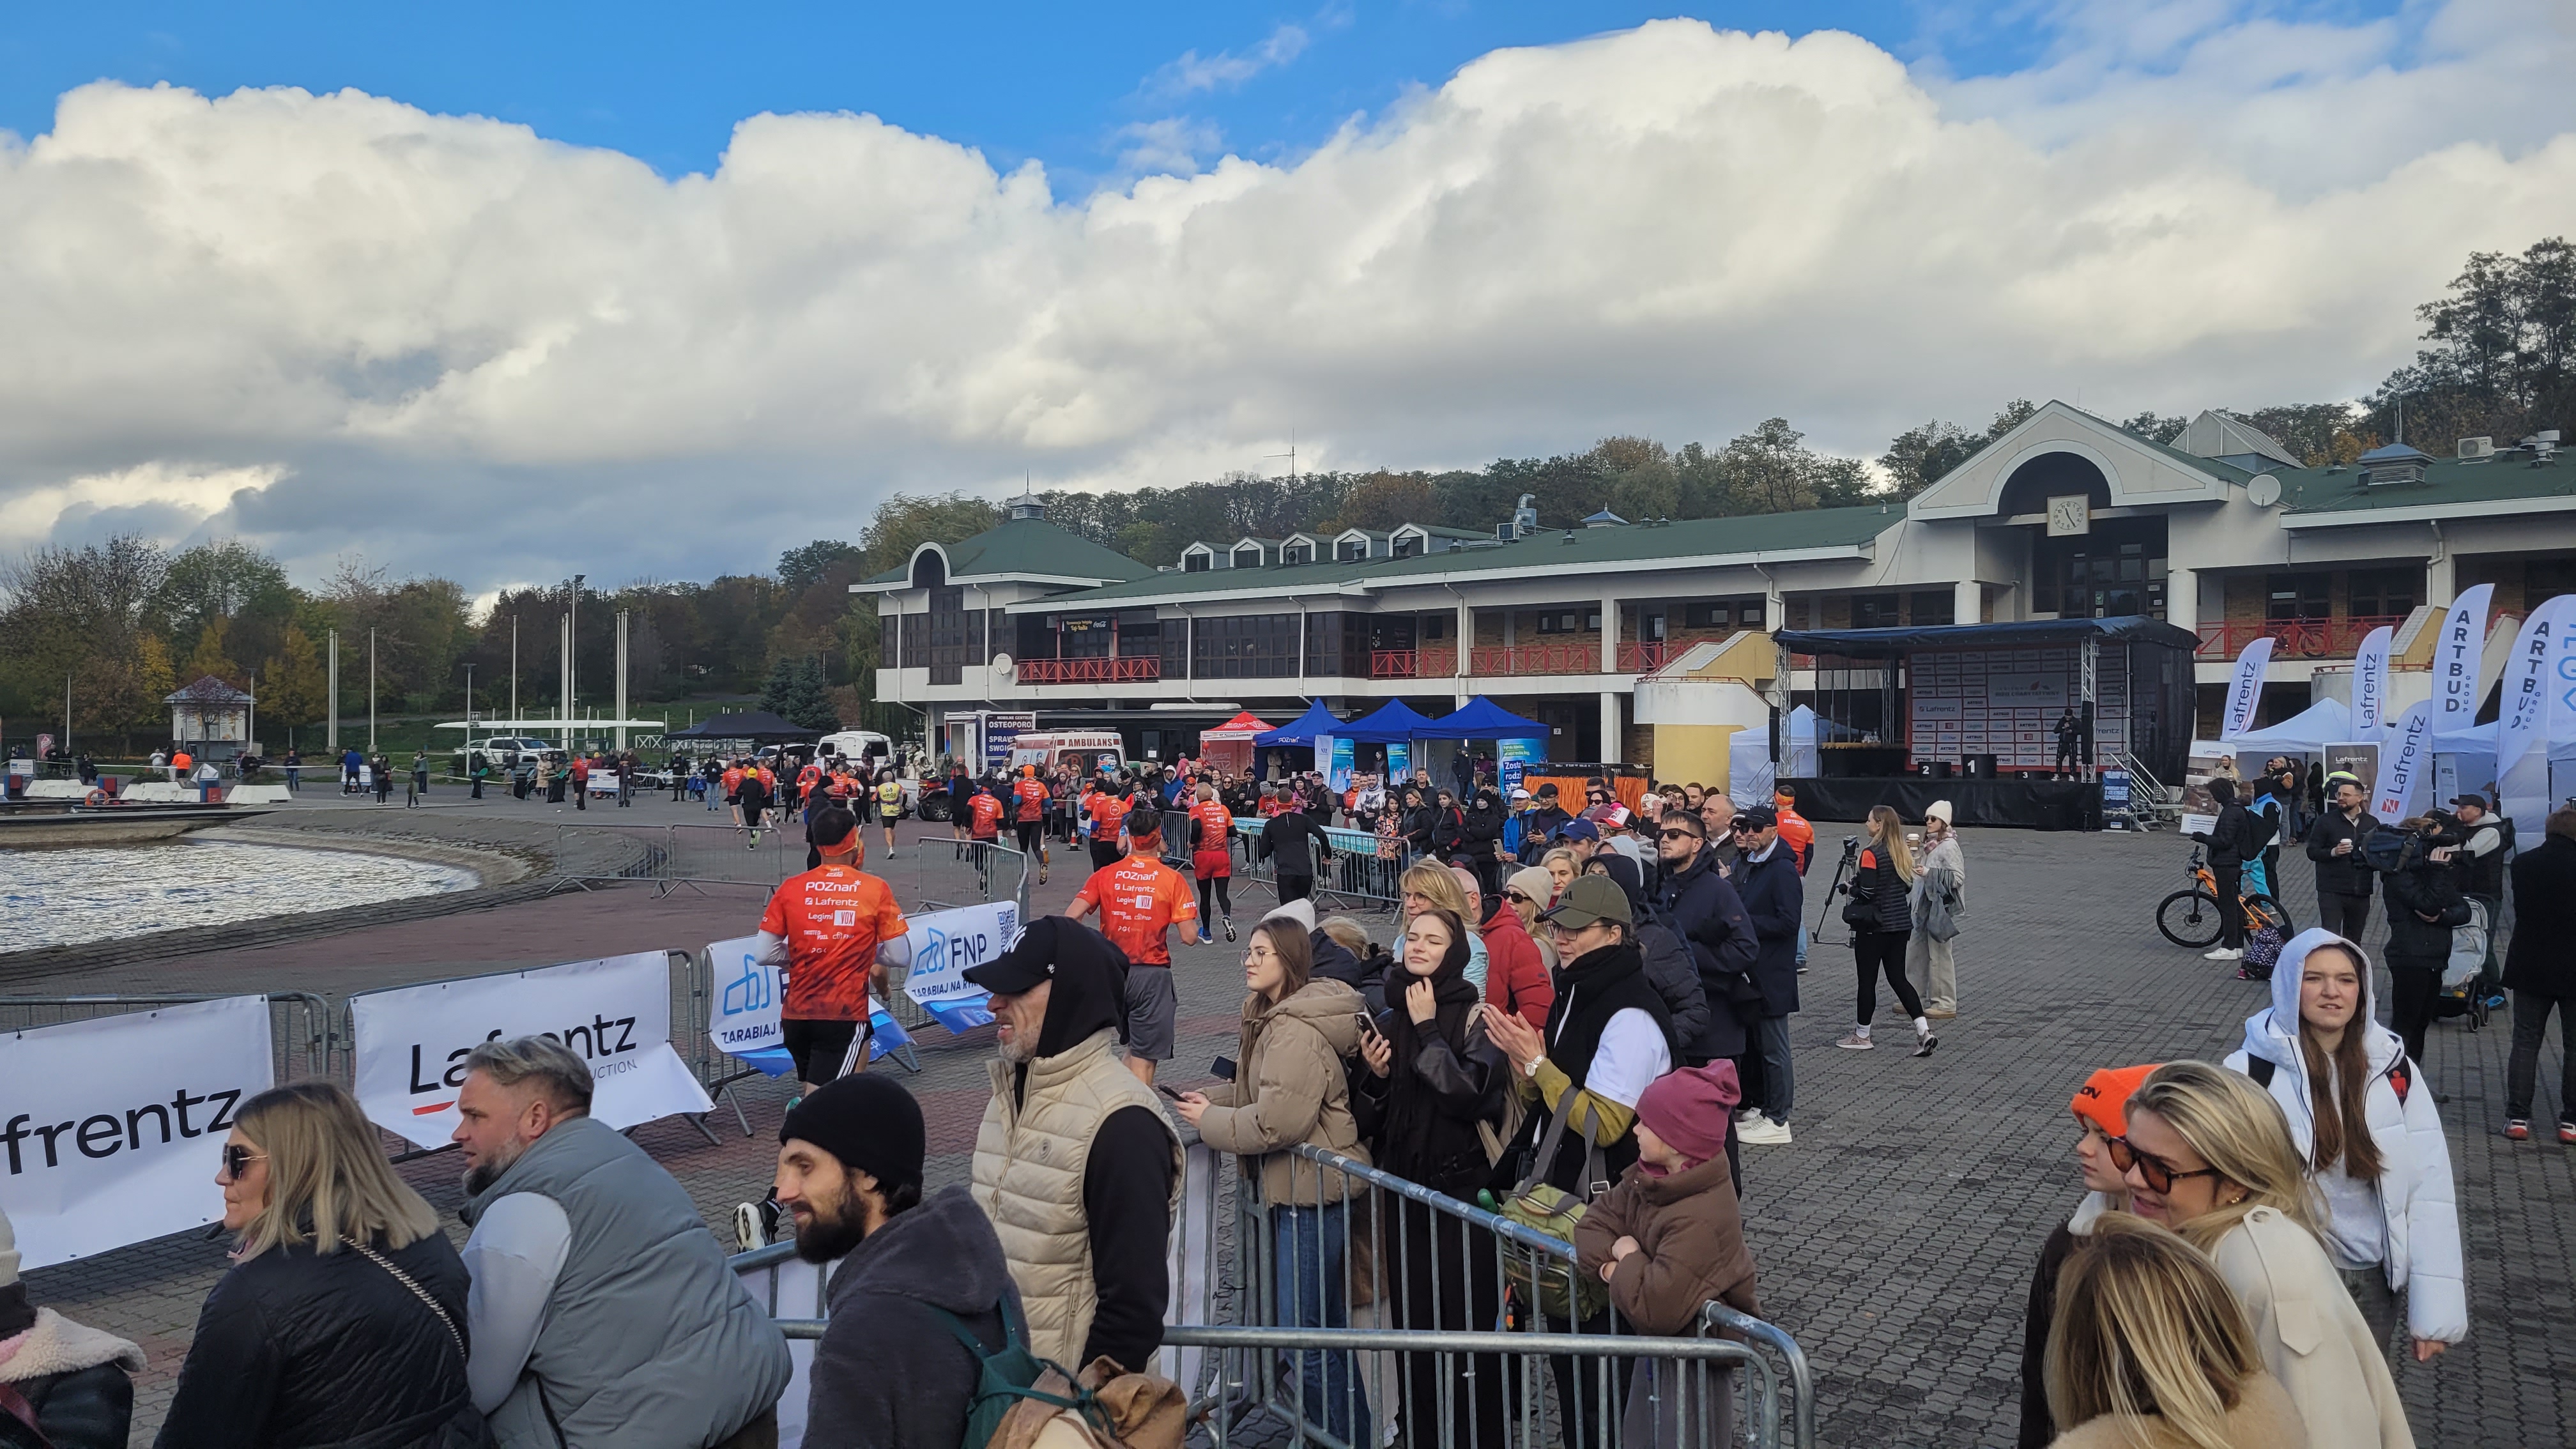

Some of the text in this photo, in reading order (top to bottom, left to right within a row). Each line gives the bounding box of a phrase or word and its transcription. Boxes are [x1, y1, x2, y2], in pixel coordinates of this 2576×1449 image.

[2445, 609, 2471, 712] ARTBUD
[2510, 621, 2550, 729] ARTBUD
[2228, 661, 2256, 732] Lafrentz
[2359, 653, 2377, 730] Lafrentz
[2463, 675, 2471, 713] GROUP
[2522, 691, 2541, 730] GROUP
[1068, 738, 1113, 747] AMBULANS
[2386, 714, 2426, 795] Lafrentz
[1922, 765, 1929, 775] 2
[1967, 760, 1975, 773] 1
[815, 896, 859, 907] Lafrentz
[1122, 883, 1156, 893] Lafrentz
[808, 912, 833, 923] Legimi
[841, 911, 854, 925] VOX
[951, 933, 987, 969] FNP
[912, 981, 949, 998] ZARABIAJ
[950, 979, 961, 992] NA
[721, 1022, 776, 1045] ZARABIAJ
[410, 1014, 638, 1095] Lantz
